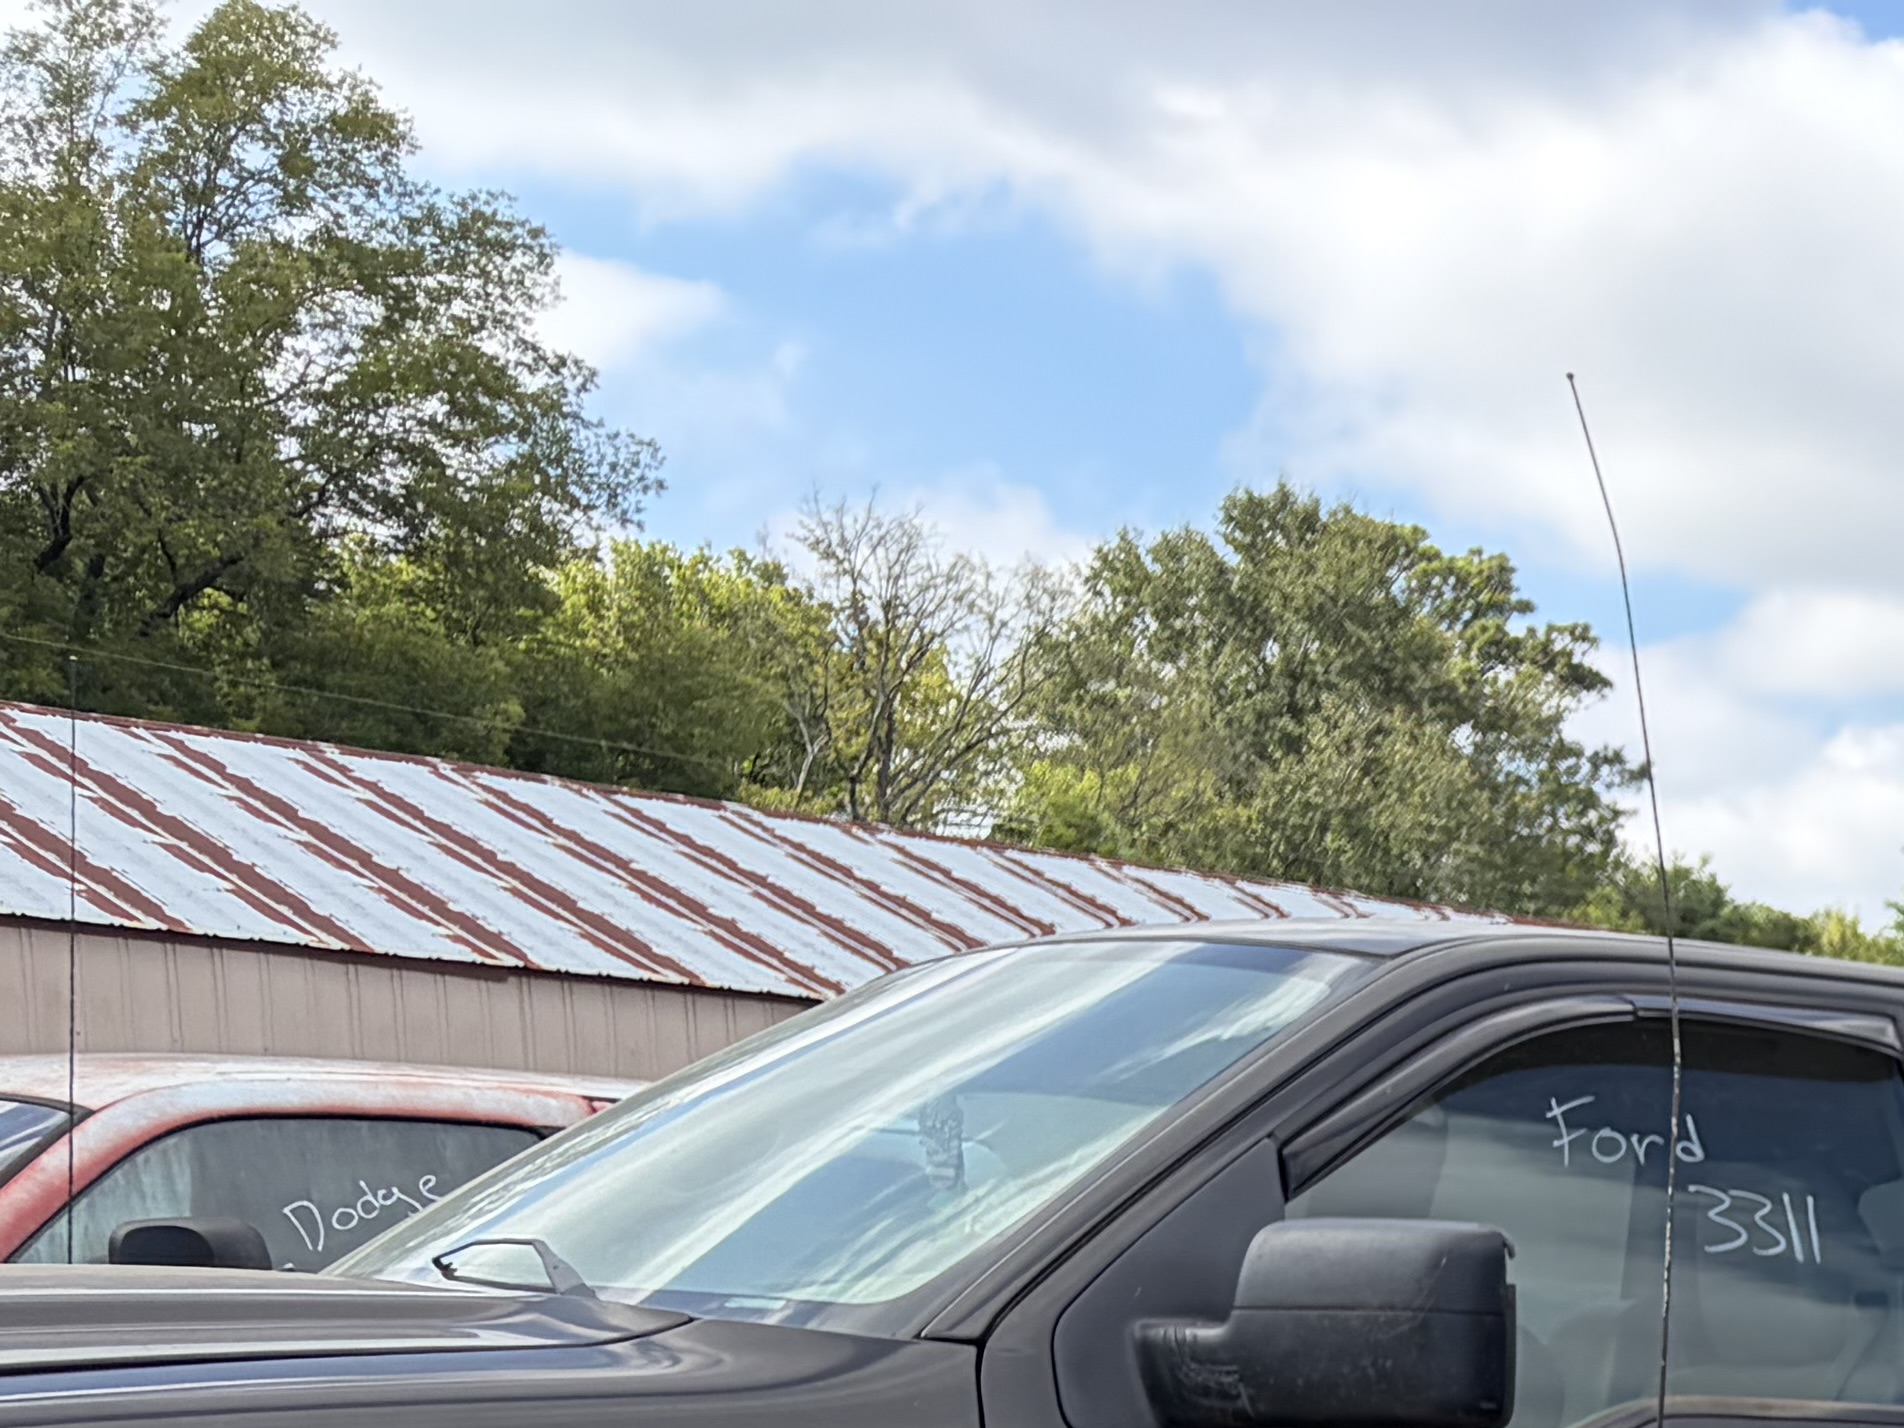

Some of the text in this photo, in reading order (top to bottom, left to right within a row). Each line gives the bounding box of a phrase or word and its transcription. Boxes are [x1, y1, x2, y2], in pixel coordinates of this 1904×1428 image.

[1546, 1095, 1706, 1168] Ford
[282, 1174, 442, 1252] Dodge
[1687, 1184, 1821, 1265] 3311
